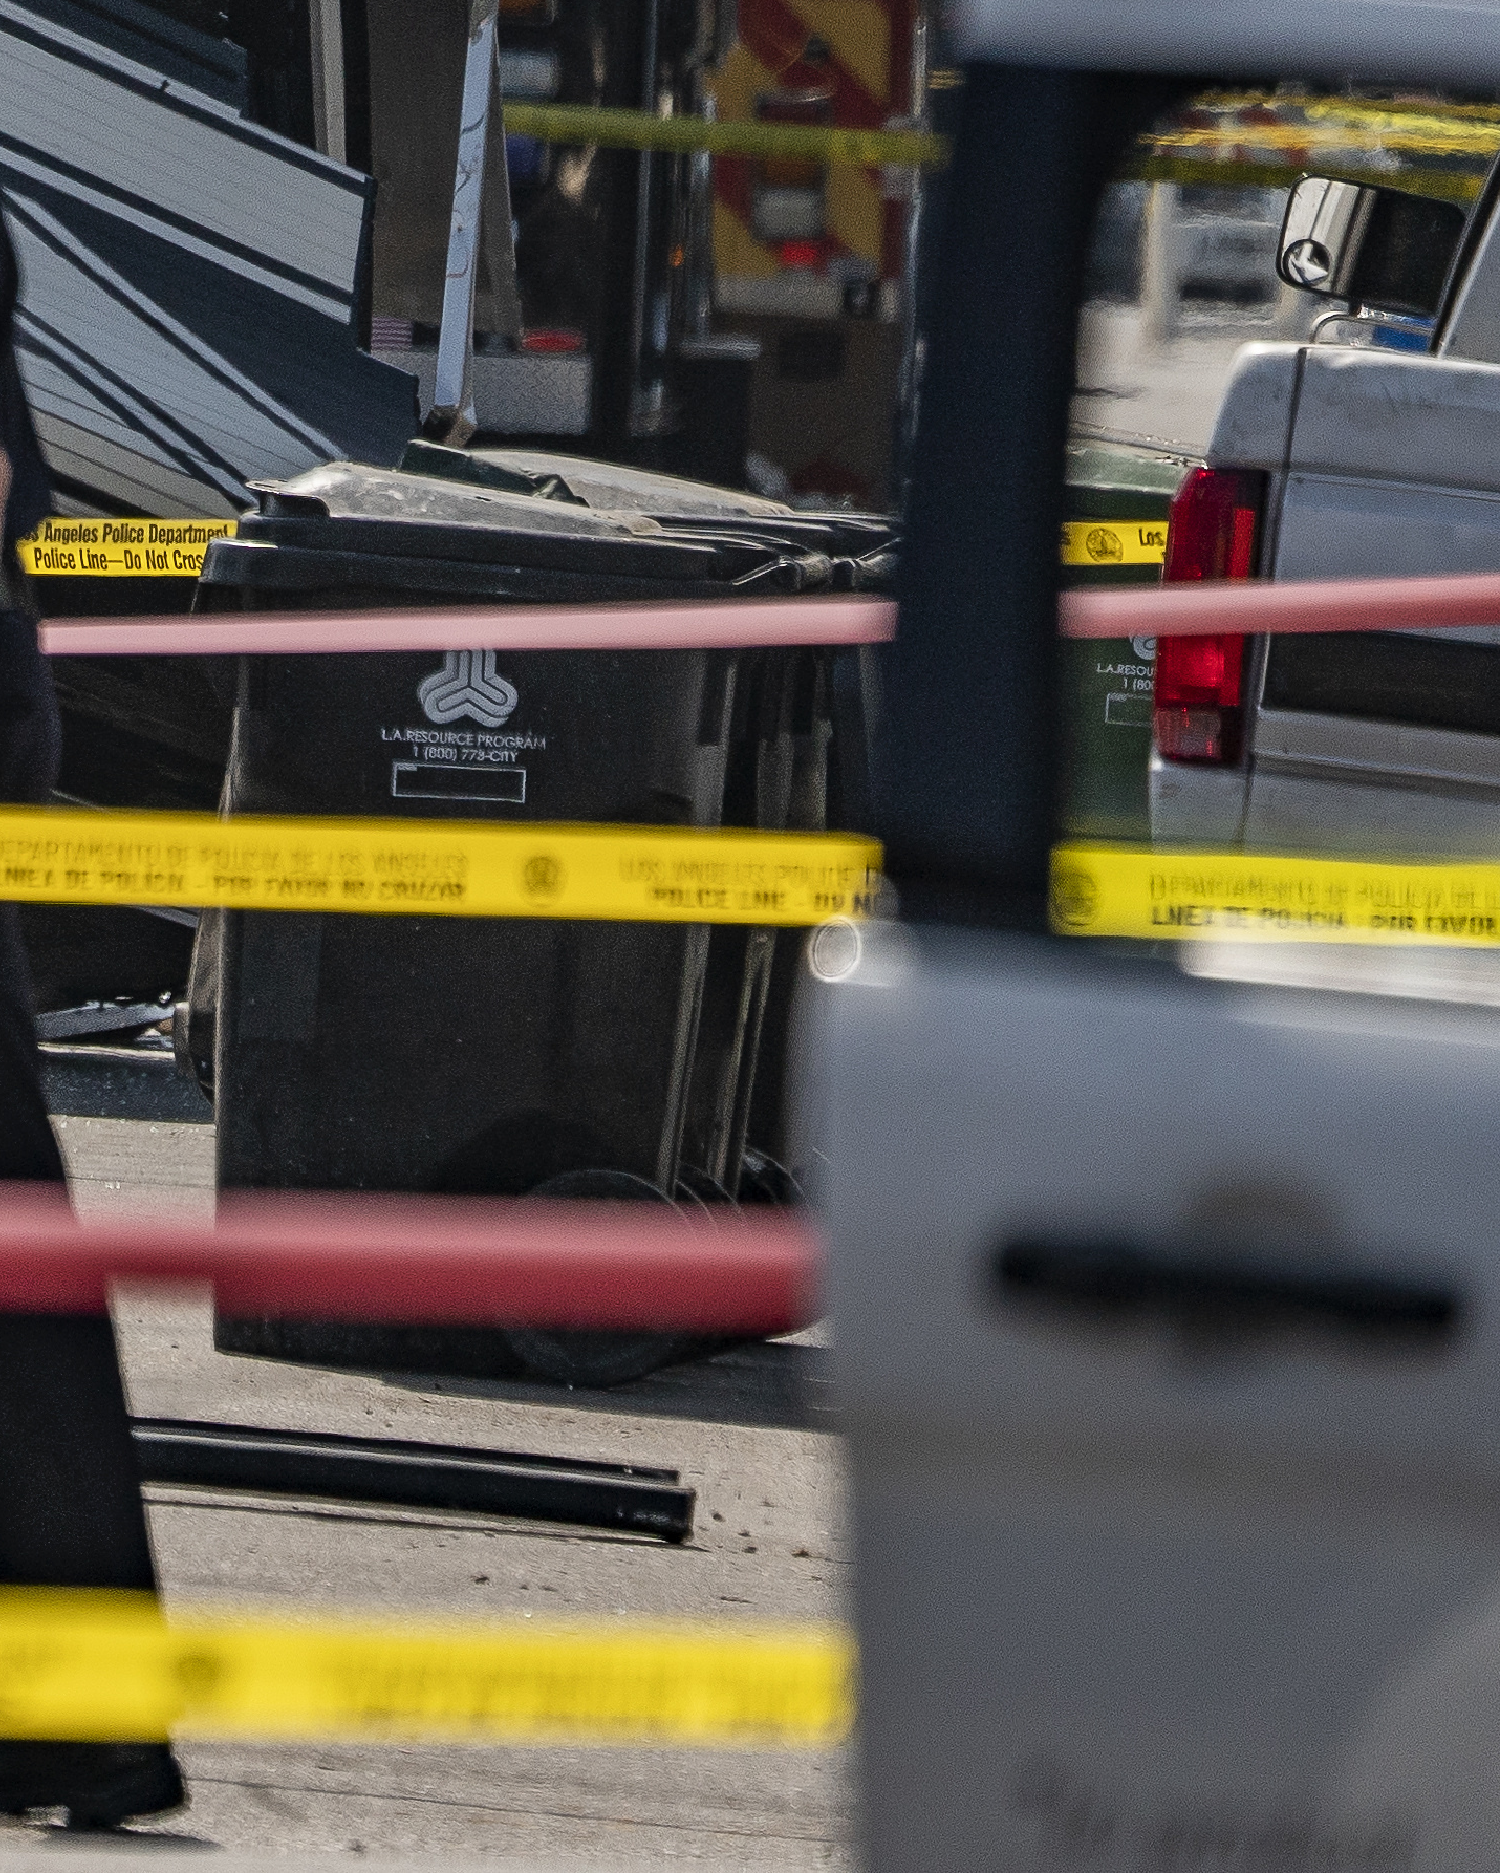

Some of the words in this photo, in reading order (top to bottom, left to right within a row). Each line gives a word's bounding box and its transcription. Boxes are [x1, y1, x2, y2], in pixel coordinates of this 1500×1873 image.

[44, 522, 99, 545] Angeles
[102, 522, 145, 544] Police
[1138, 528, 1164, 547] Los
[33, 547, 76, 570] Police
[146, 549, 170, 570] Not
[172, 549, 204, 571] Cros
[477, 732, 546, 750] PROGRAM
